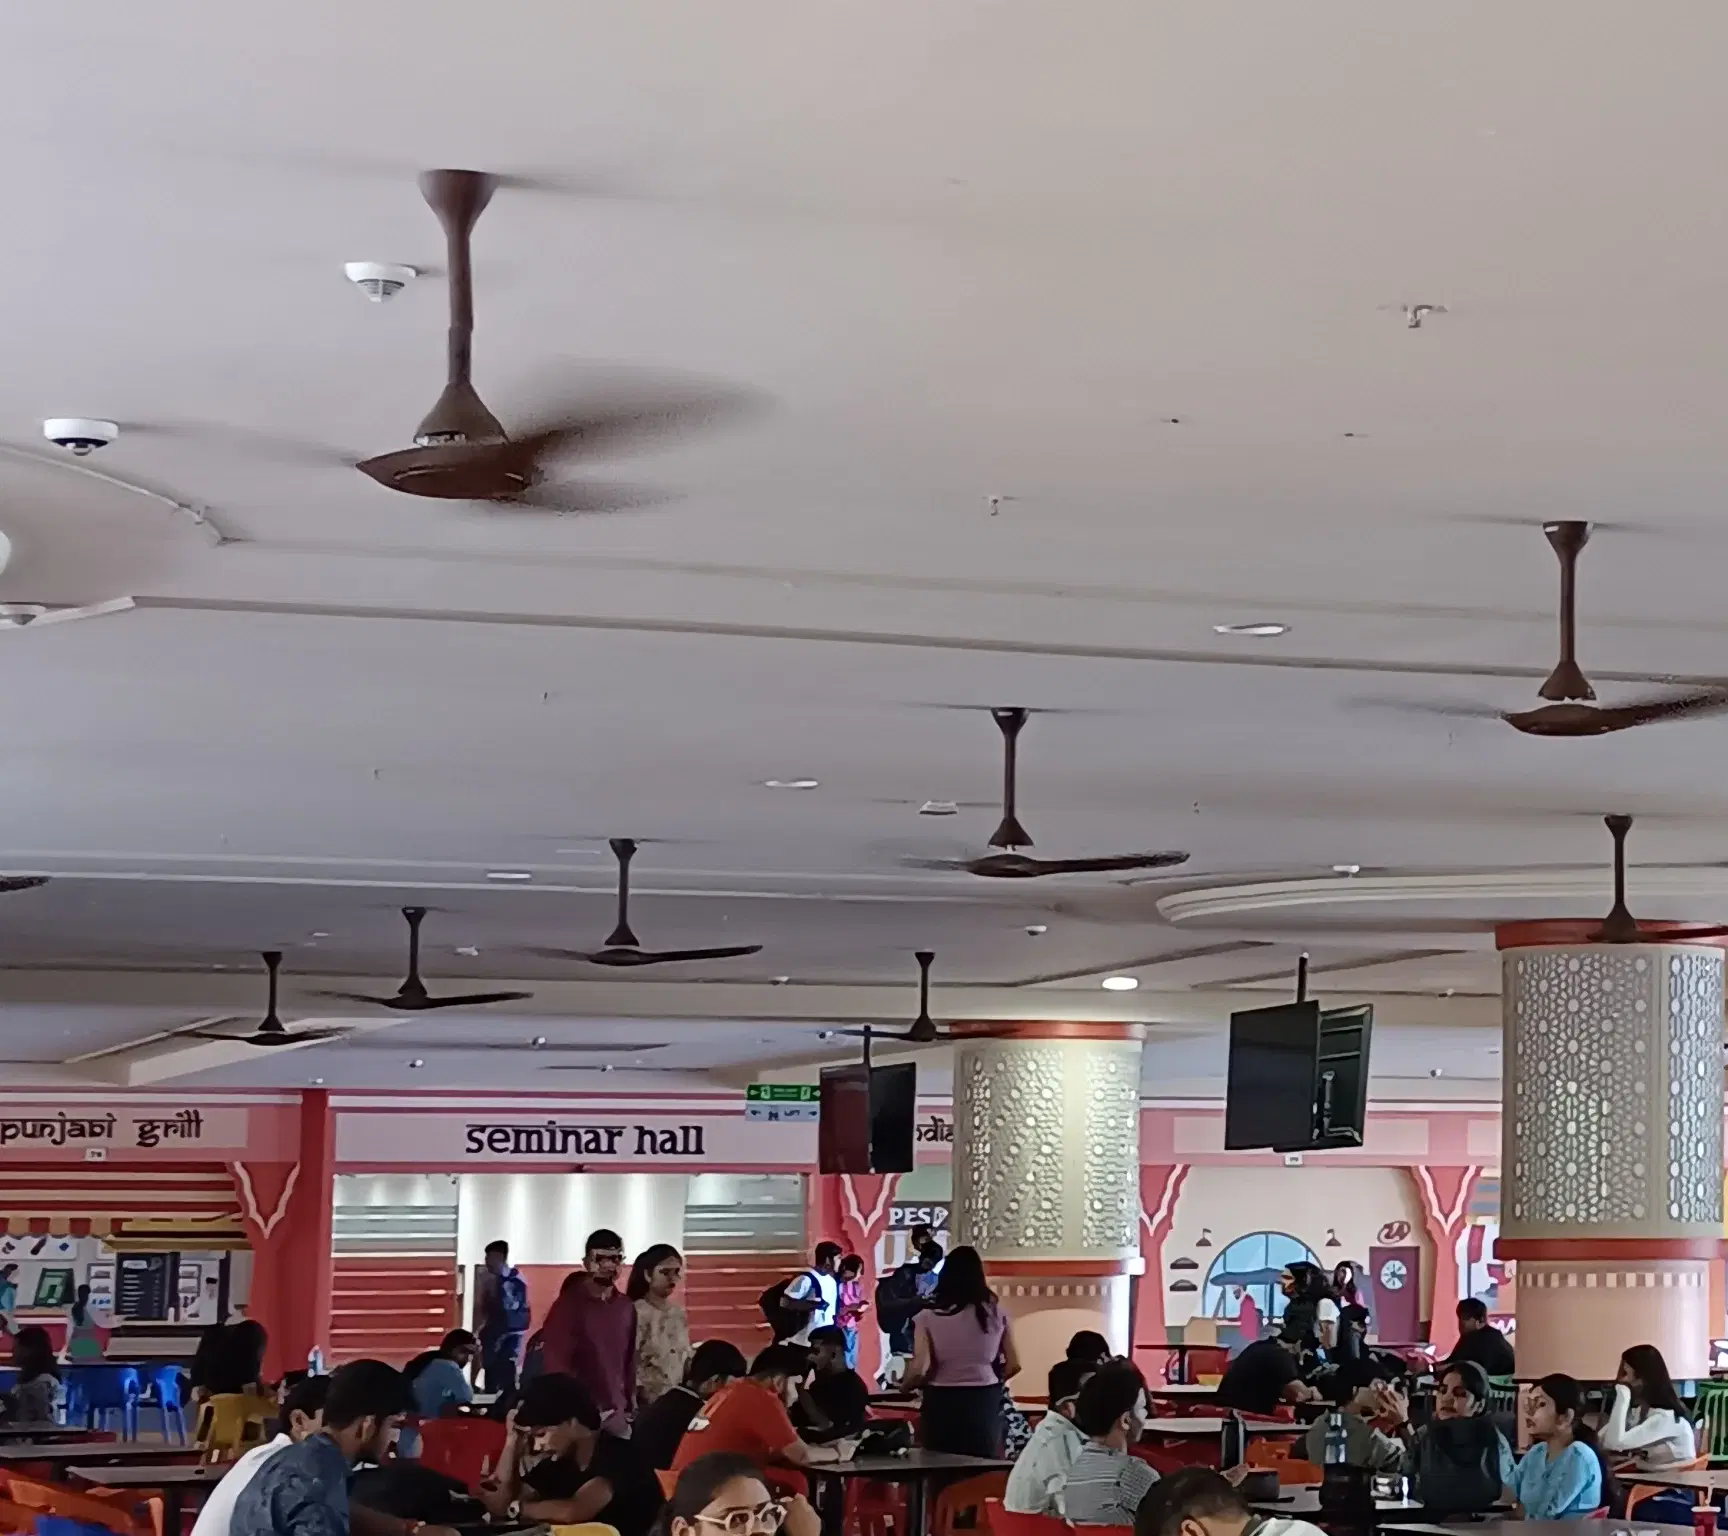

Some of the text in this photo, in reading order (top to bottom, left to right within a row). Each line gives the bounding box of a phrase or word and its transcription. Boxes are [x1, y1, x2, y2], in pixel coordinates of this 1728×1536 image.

[0, 1109, 205, 1148] punjabi grill
[465, 1119, 705, 1155] seminar hall
[888, 1206, 931, 1226] PES
